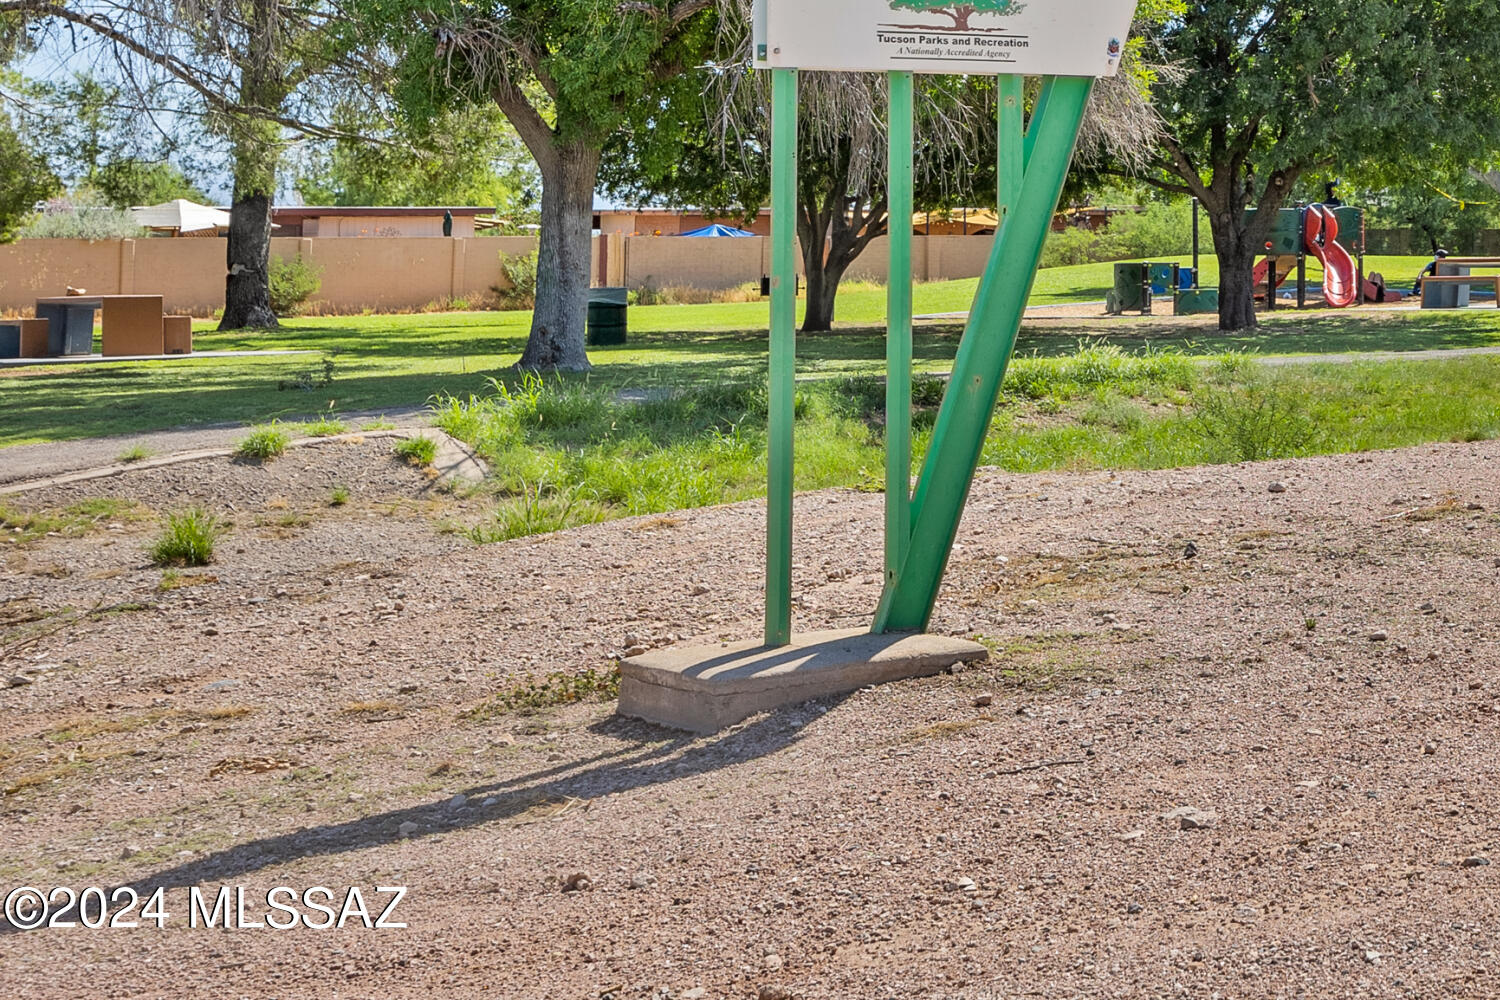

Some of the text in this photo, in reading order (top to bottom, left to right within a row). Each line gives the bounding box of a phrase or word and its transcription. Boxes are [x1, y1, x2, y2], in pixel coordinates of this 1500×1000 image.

[877, 34, 1029, 47] Tucson Parks and Recreation
[904, 47, 943, 56] Nationally
[944, 48, 983, 57] Accredited
[984, 50, 1011, 59] Agency
